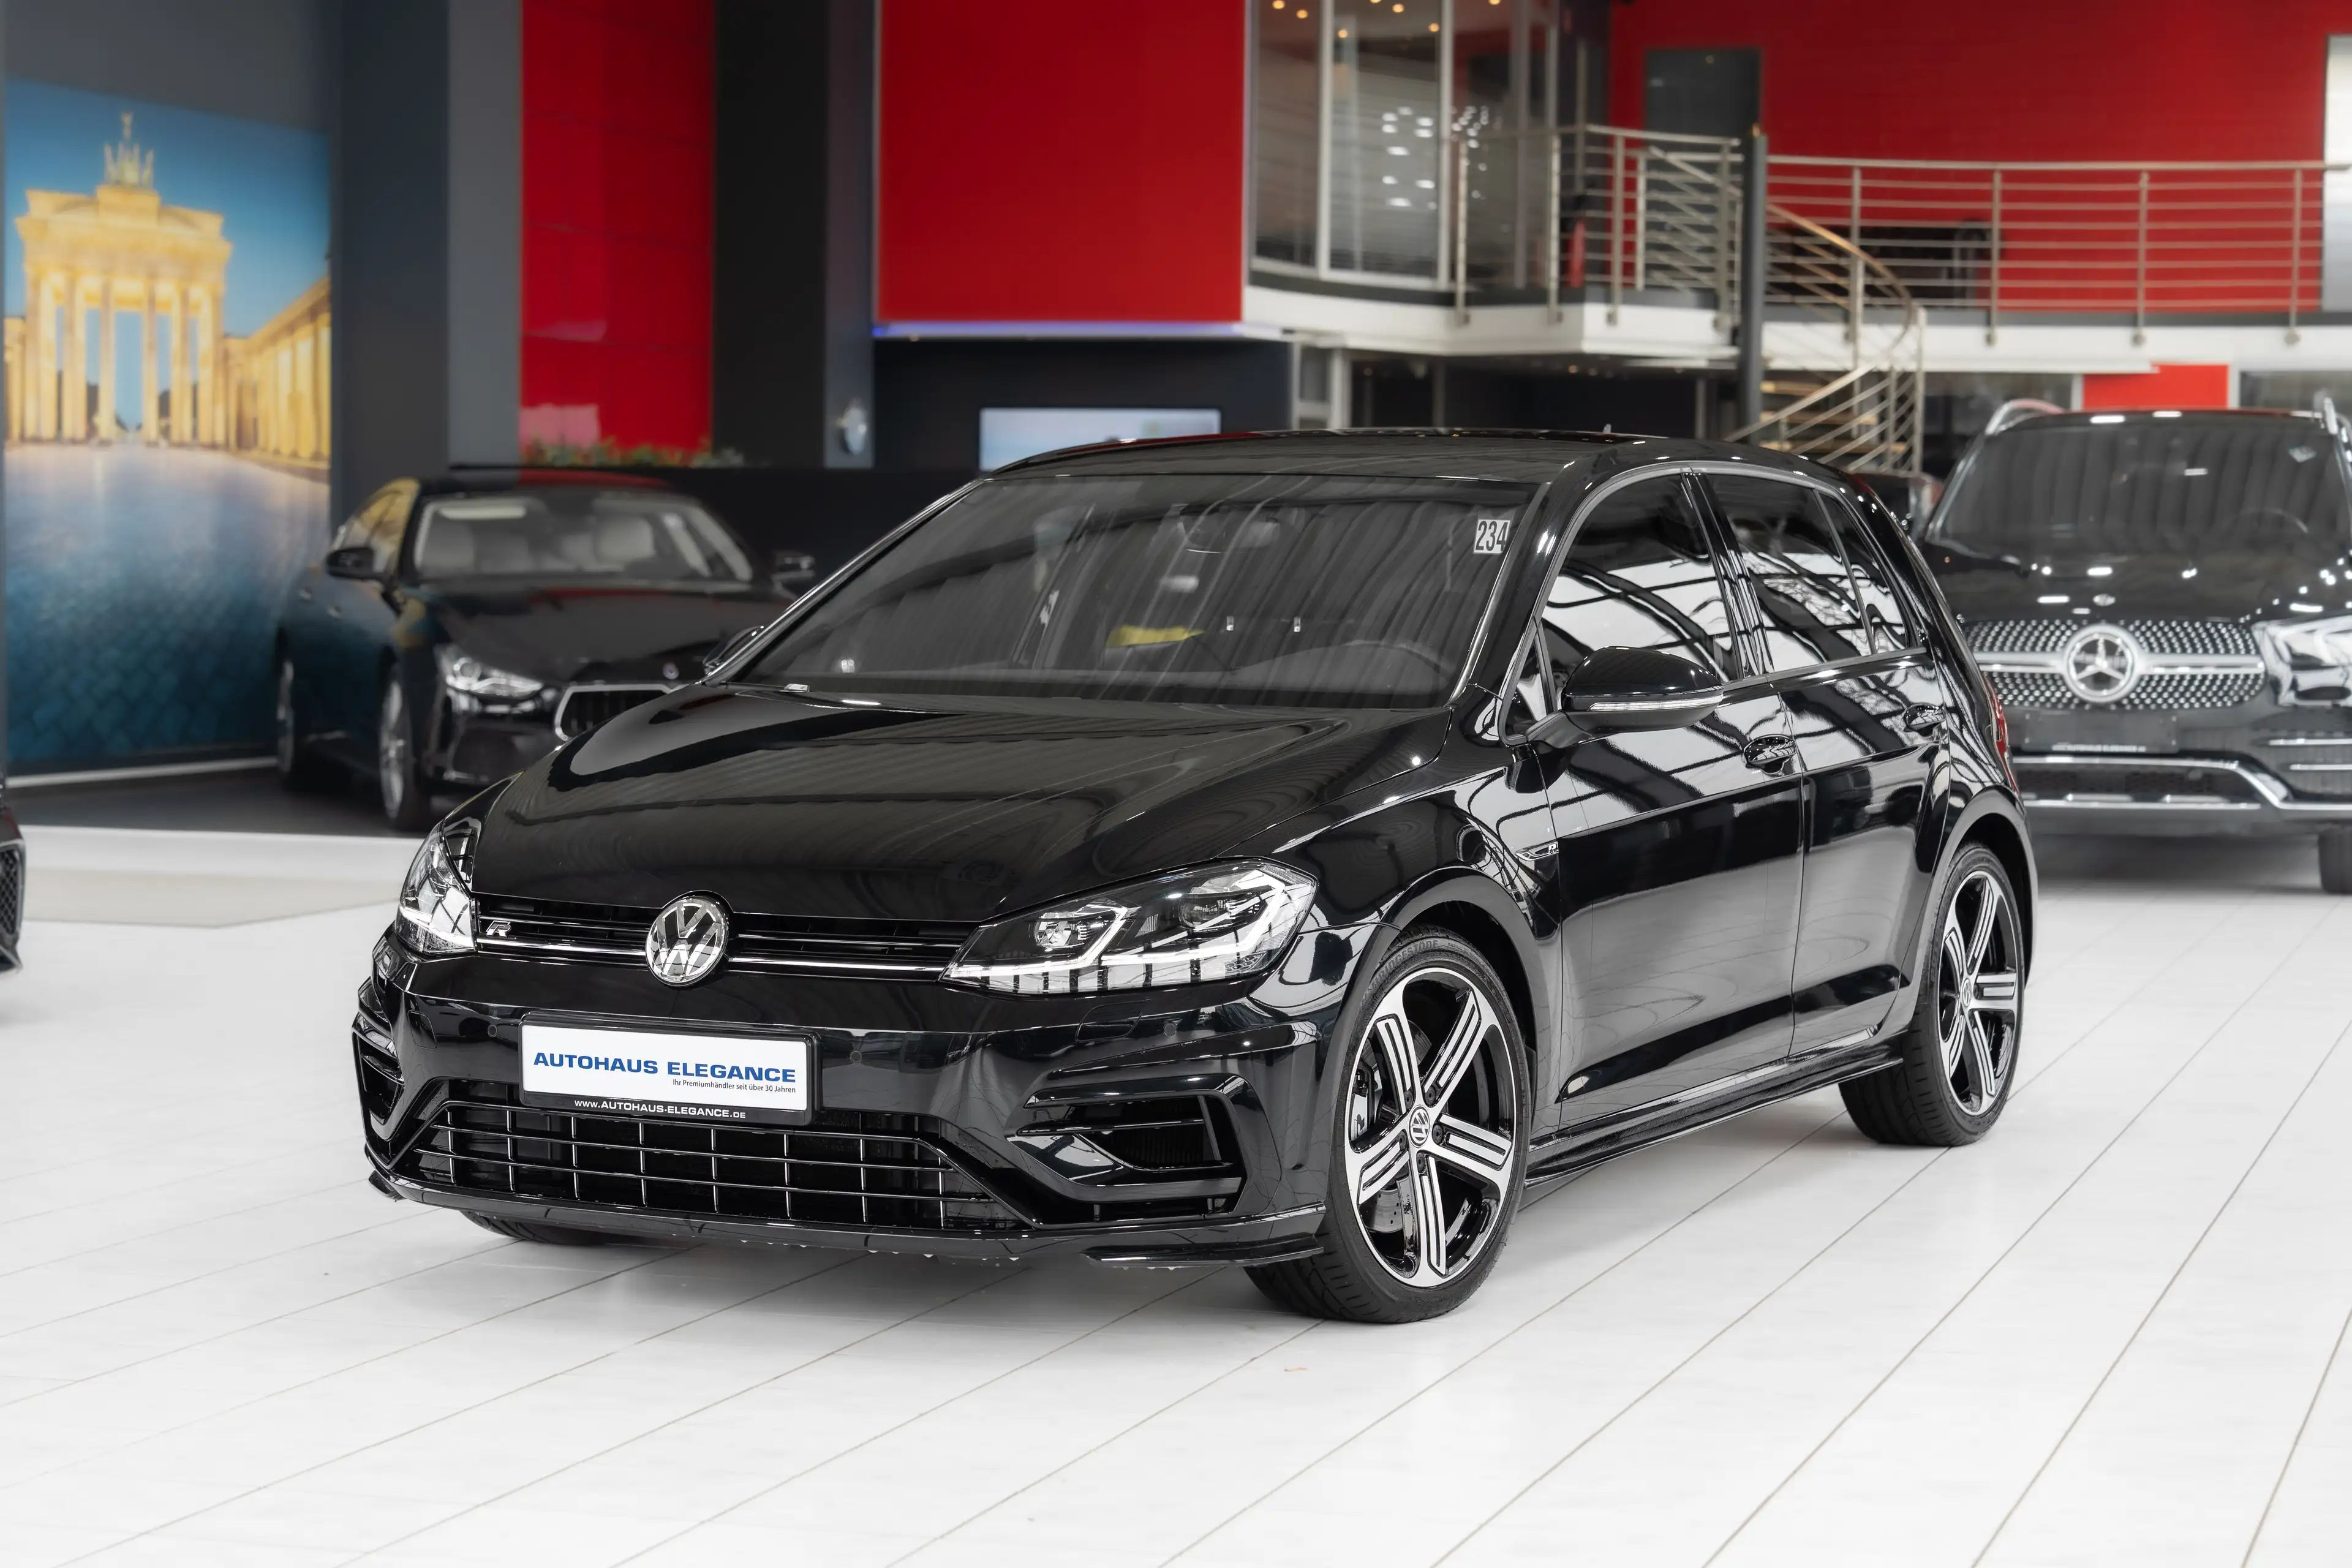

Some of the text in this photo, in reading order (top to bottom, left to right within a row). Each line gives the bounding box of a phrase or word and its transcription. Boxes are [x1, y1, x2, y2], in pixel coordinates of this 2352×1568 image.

[1476, 521, 1508, 551] 234
[486, 920, 511, 938] R
[533, 1052, 796, 1082] AUTOHAUS ELEGANCE
[683, 1080, 734, 1090] Premiumhändler
